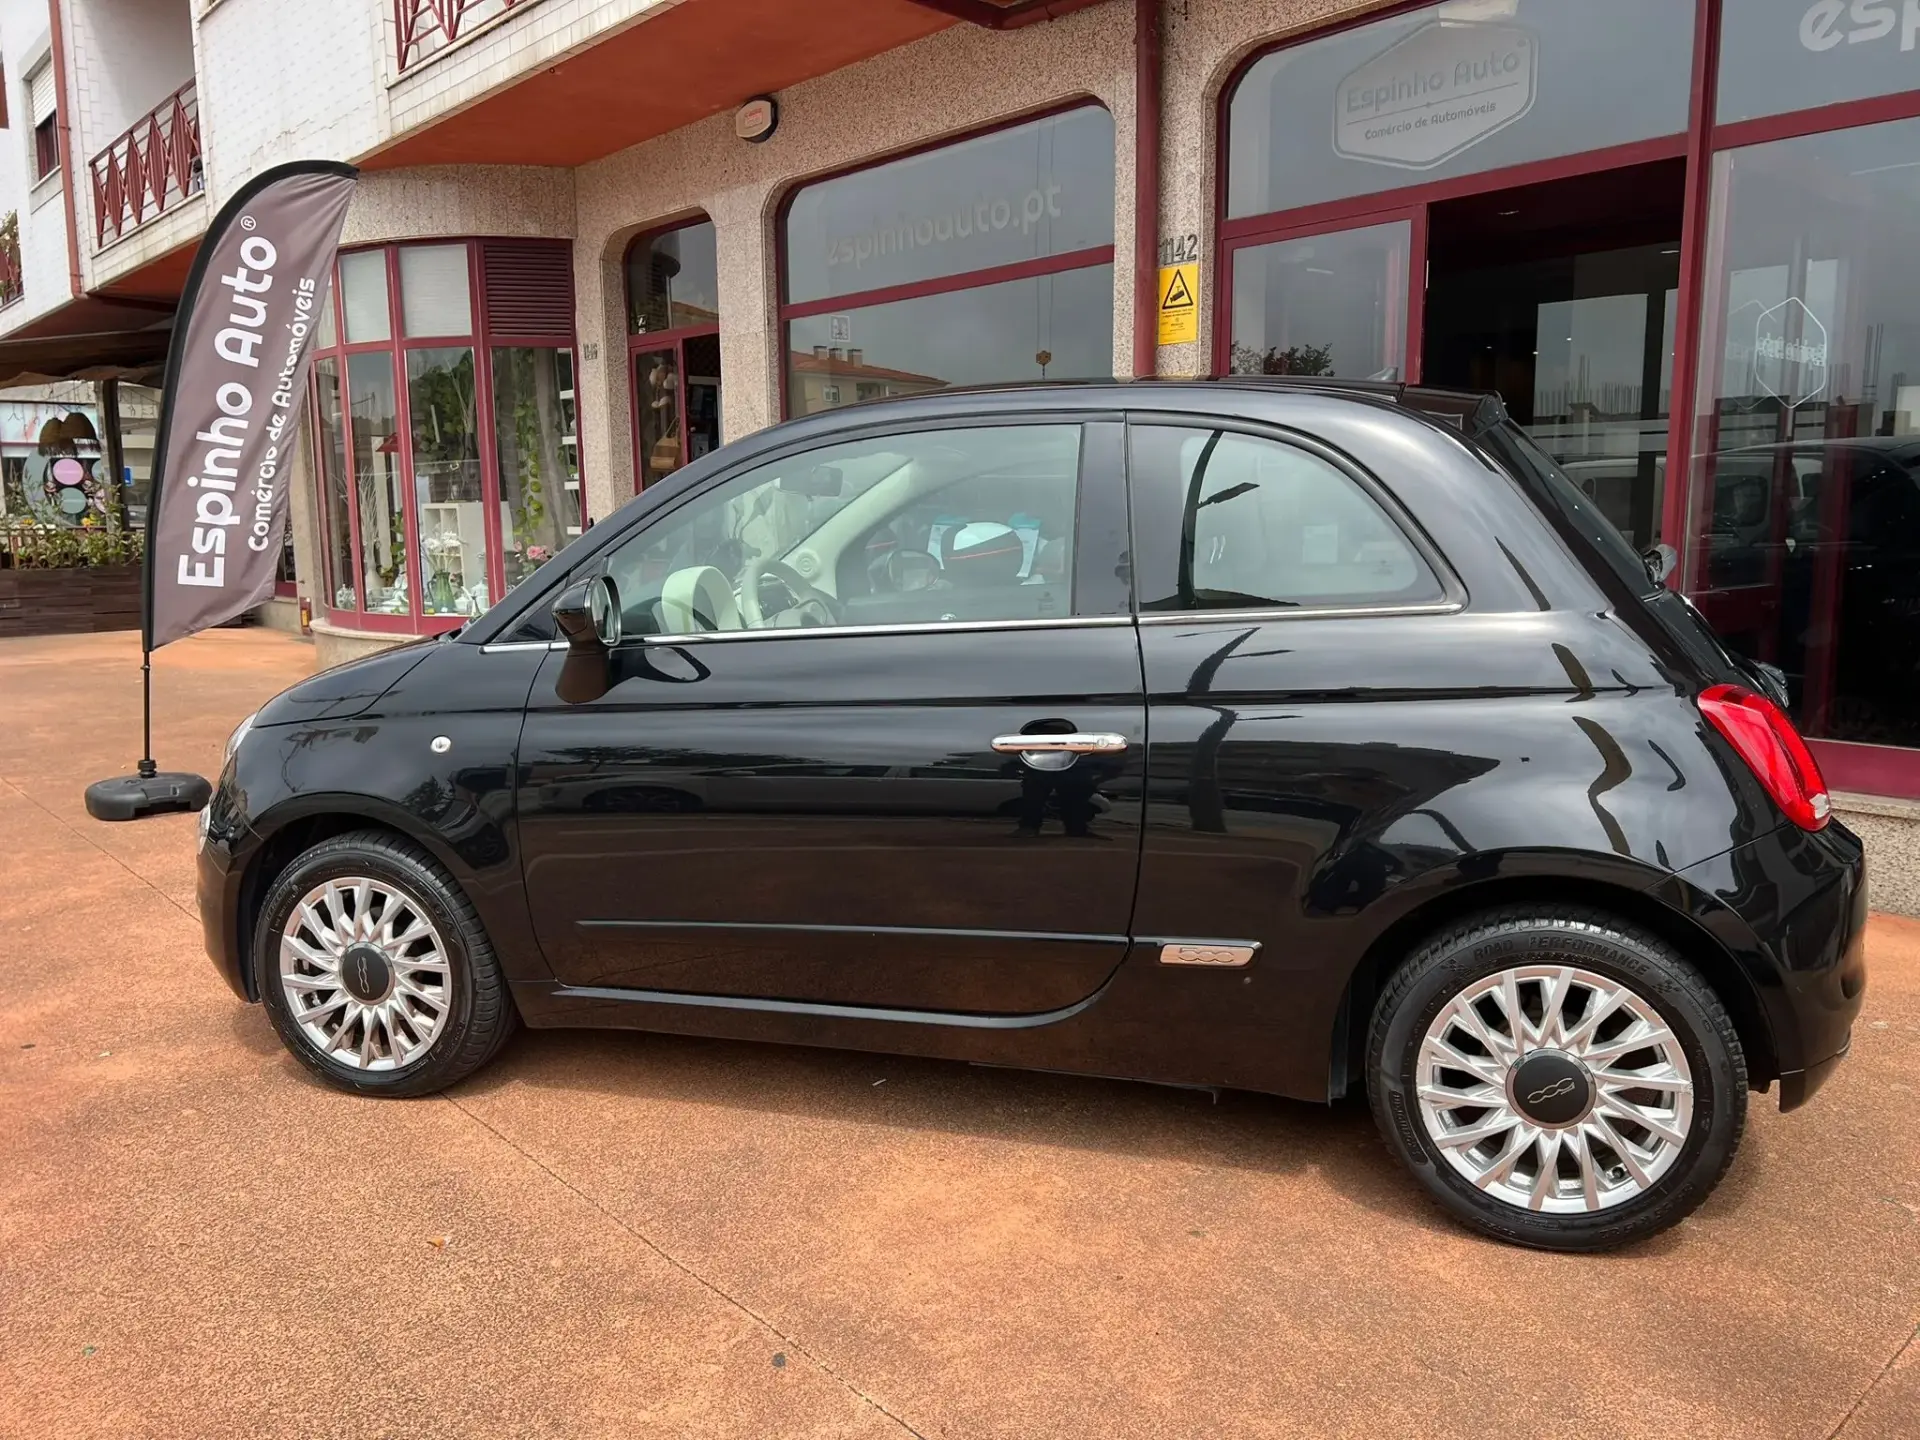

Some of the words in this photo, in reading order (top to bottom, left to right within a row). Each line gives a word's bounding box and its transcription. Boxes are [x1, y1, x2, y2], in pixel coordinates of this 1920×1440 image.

[1346, 71, 1445, 113] Espinho
[1453, 51, 1521, 88] Auto
[1364, 120, 1412, 140] Comércio
[1414, 117, 1428, 129] de
[1431, 101, 1496, 125] Automóveis
[271, 277, 315, 408] Automóveis
[266, 414, 287, 442] de
[177, 382, 253, 588] Espinho
[248, 445, 278, 552] Comércio
[1472, 938, 1514, 962] ROAD
[1528, 935, 1651, 976] PERFORMANCE
